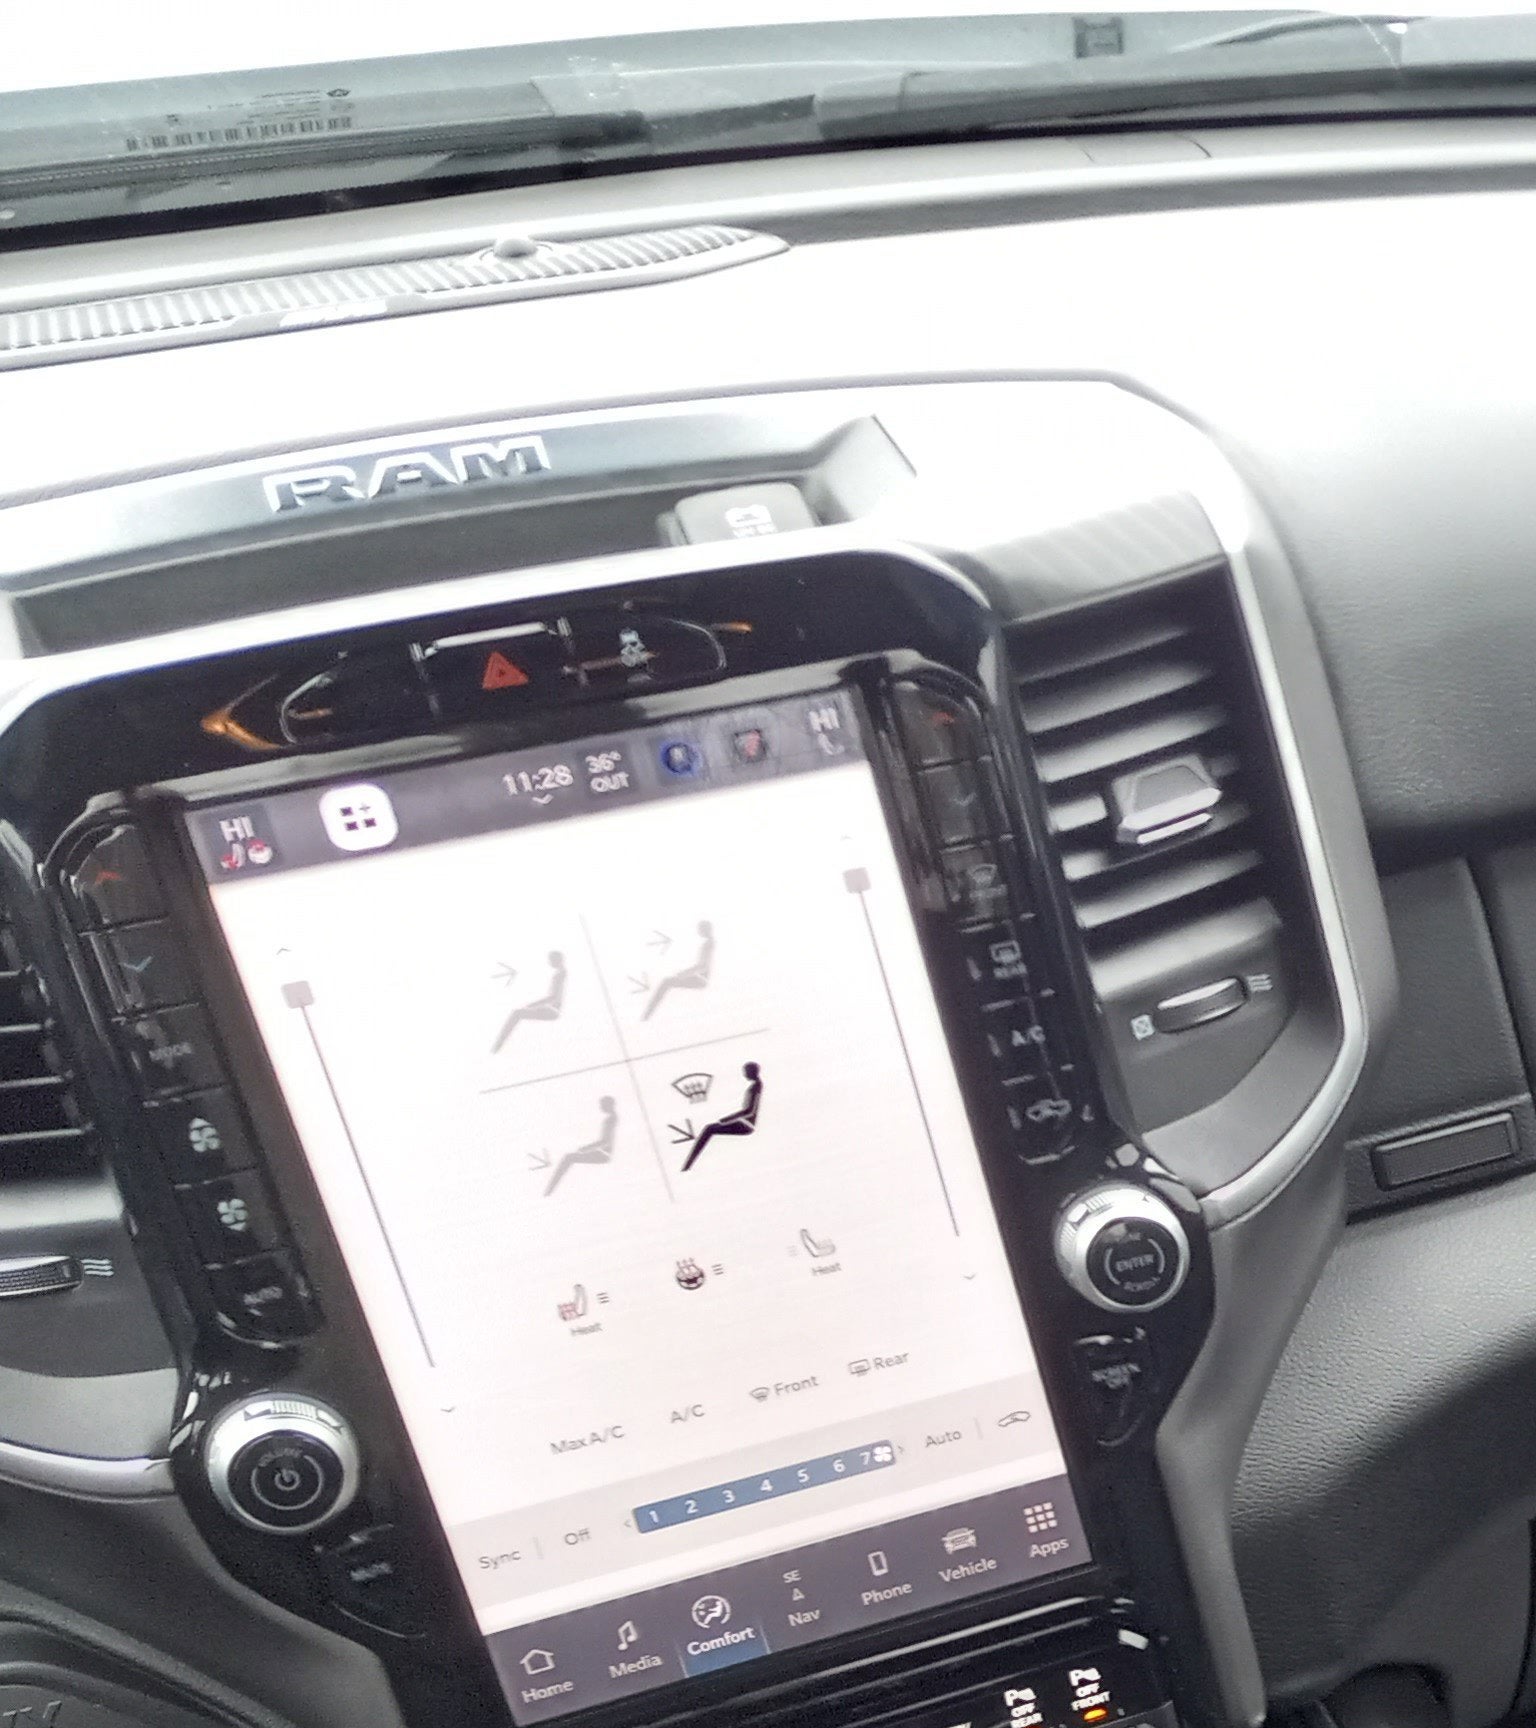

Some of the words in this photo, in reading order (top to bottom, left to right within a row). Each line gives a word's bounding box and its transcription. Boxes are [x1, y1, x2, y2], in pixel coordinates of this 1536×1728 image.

[262, 434, 551, 513] RAM
[809, 707, 840, 732] HI
[503, 764, 574, 795] 11:28
[590, 771, 629, 792] OUT
[219, 816, 255, 842] HI
[873, 1352, 909, 1370] Rear
[773, 1375, 820, 1396] Front
[671, 1403, 706, 1424] A/C
[550, 1438, 588, 1456] Max
[478, 1550, 522, 1570] Sync
[564, 1526, 591, 1546] Off
[648, 1509, 659, 1524] 1
[684, 1499, 698, 1515] 2
[722, 1489, 736, 1504] 3
[759, 1478, 774, 1493] 4
[797, 1468, 811, 1483] 5
[832, 1458, 846, 1473] 6
[858, 1451, 872, 1466] 7
[925, 1430, 963, 1448] Auto
[521, 1681, 575, 1704] Home
[608, 1655, 664, 1679] Media
[687, 1627, 756, 1656] Comfort
[788, 1609, 821, 1627] Nav
[861, 1583, 914, 1606] Phone
[938, 1558, 998, 1583] Vehicle
[1028, 1535, 1070, 1559] Apps
[1075, 1682, 1100, 1698] OFF
[1010, 1702, 1036, 1718] OFF
[1071, 1691, 1110, 1712] FRONT
